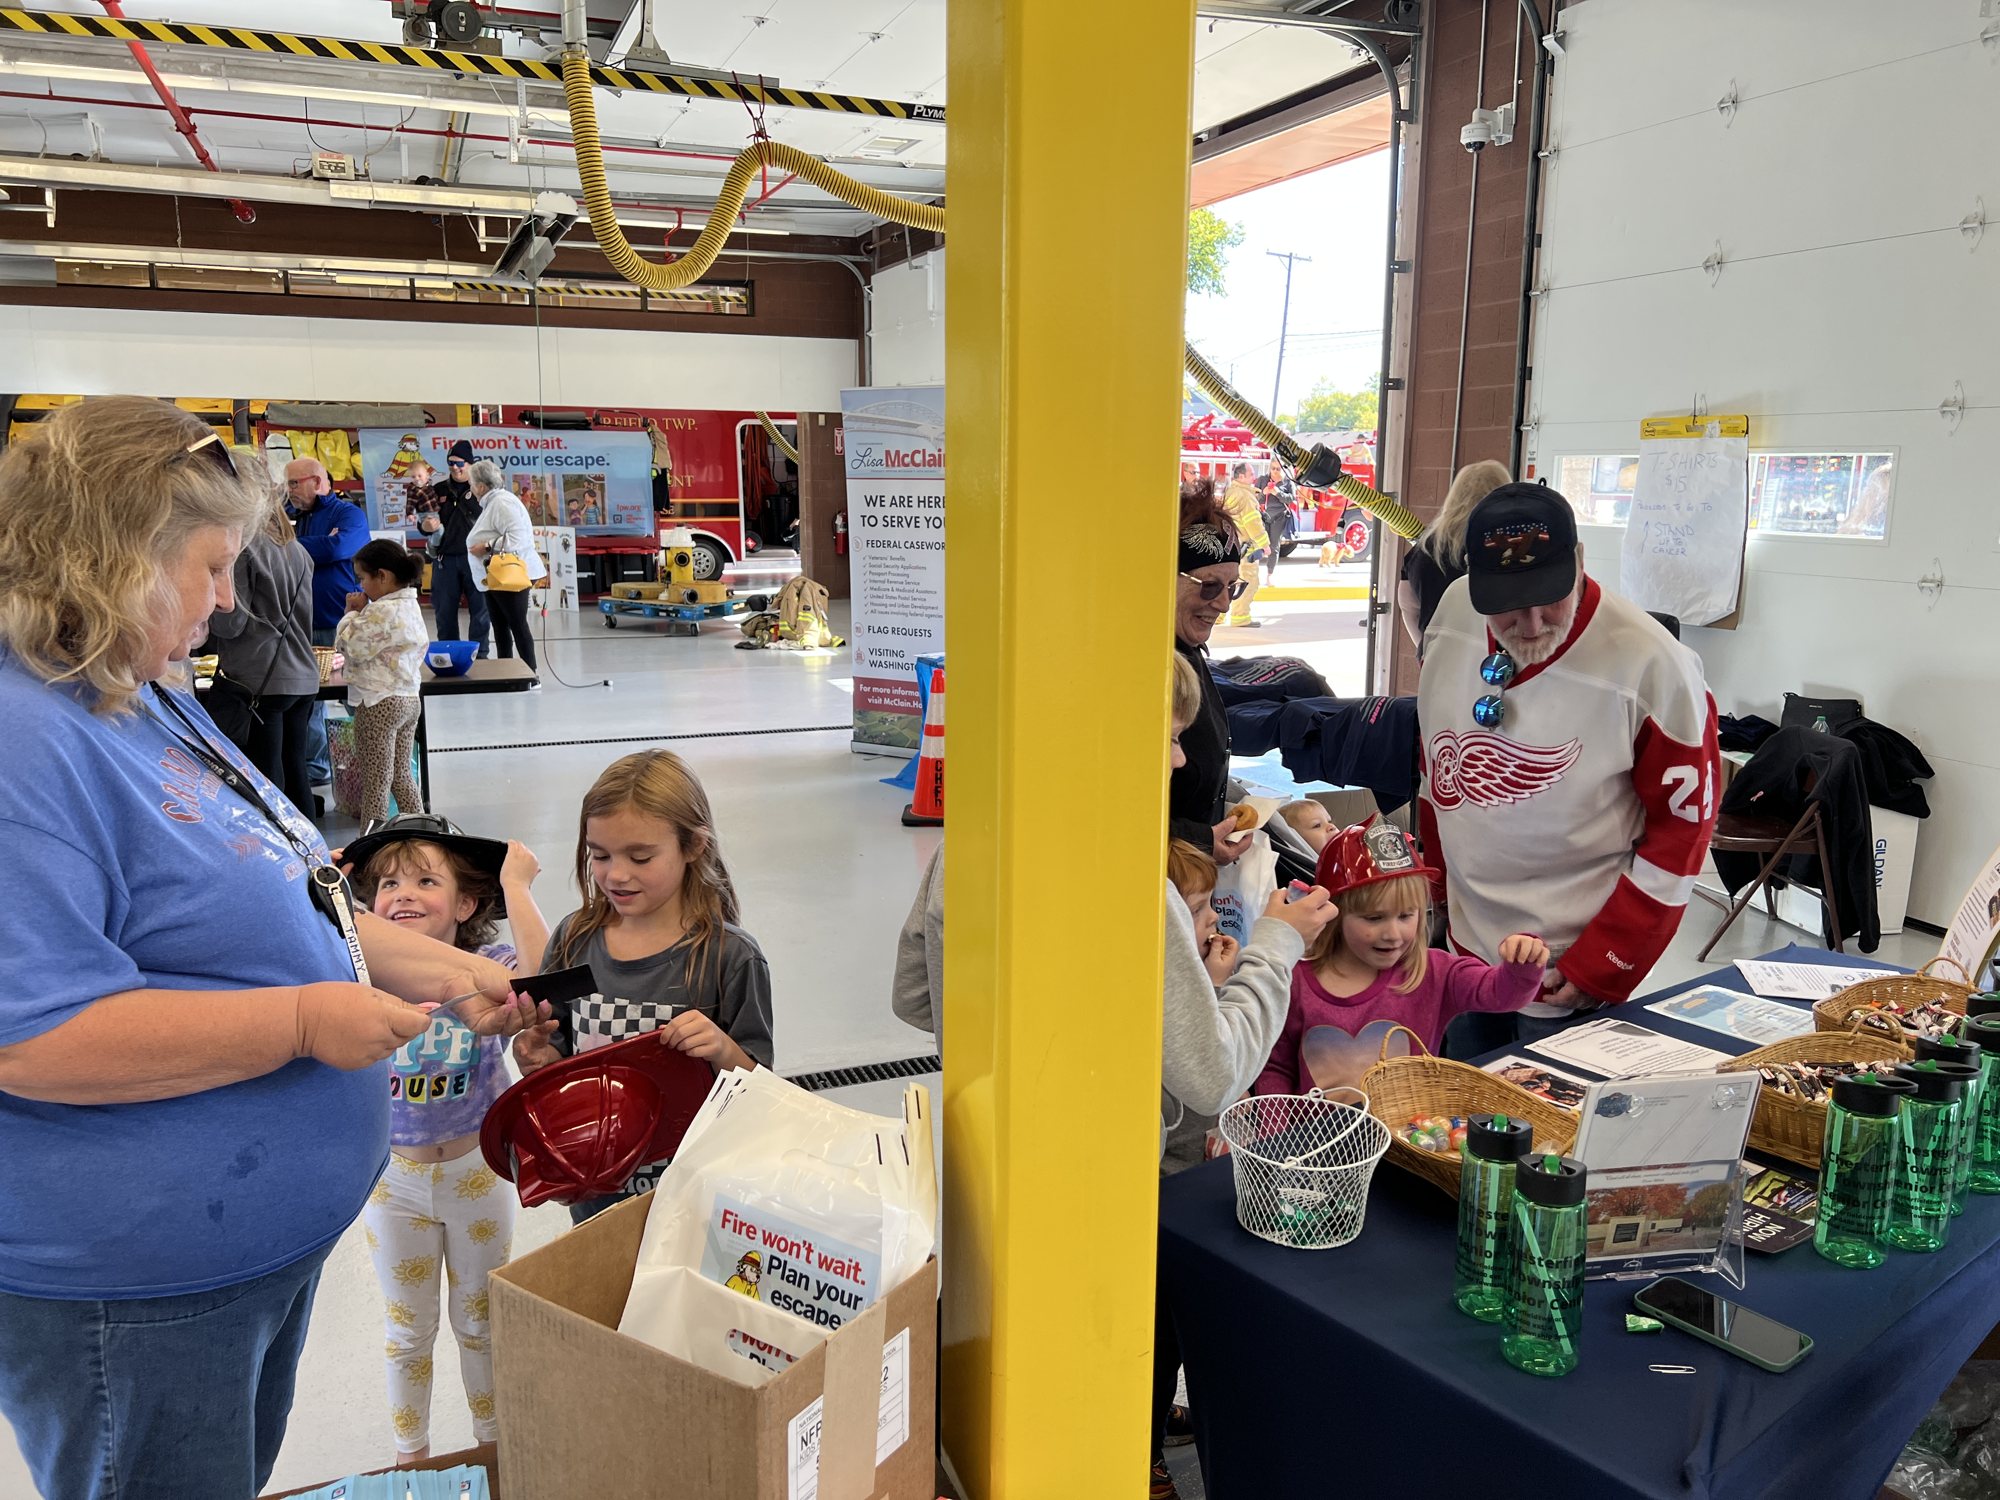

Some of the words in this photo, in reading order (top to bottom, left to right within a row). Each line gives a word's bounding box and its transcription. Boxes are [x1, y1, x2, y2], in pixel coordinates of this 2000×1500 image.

[662, 418, 698, 430] TWP.
[432, 437, 462, 450] Fir
[471, 435, 520, 449] won't
[525, 437, 568, 450] wait.
[500, 455, 539, 469] your
[544, 455, 610, 470] escape.
[851, 447, 885, 470] Lisa
[885, 448, 945, 468] McClai
[864, 495, 886, 508] WE
[889, 495, 913, 508] ARE
[860, 515, 878, 527] TO
[882, 515, 920, 528] SERVE
[924, 516, 945, 529] YO
[1655, 521, 1695, 537] STAND
[866, 540, 902, 549] FEDERAL
[904, 541, 945, 550] CASEWOR
[867, 625, 889, 634] FLAG
[891, 627, 932, 638] REQUESTS
[868, 648, 905, 658] VISITING
[869, 660, 917, 671] WASHINGT
[859, 684, 871, 692] For
[872, 686, 890, 694] more
[892, 686, 919, 697] informa
[884, 698, 922, 708] McClain.Ho
[345, 925, 366, 972] TAMMY
[390, 1073, 466, 1098] OUSE
[720, 1208, 757, 1241] Fire
[761, 1228, 814, 1264] won't
[817, 1252, 866, 1286] wait.
[766, 1255, 810, 1291] Plan
[813, 1280, 863, 1311] your
[800, 1420, 823, 1451] NFP
